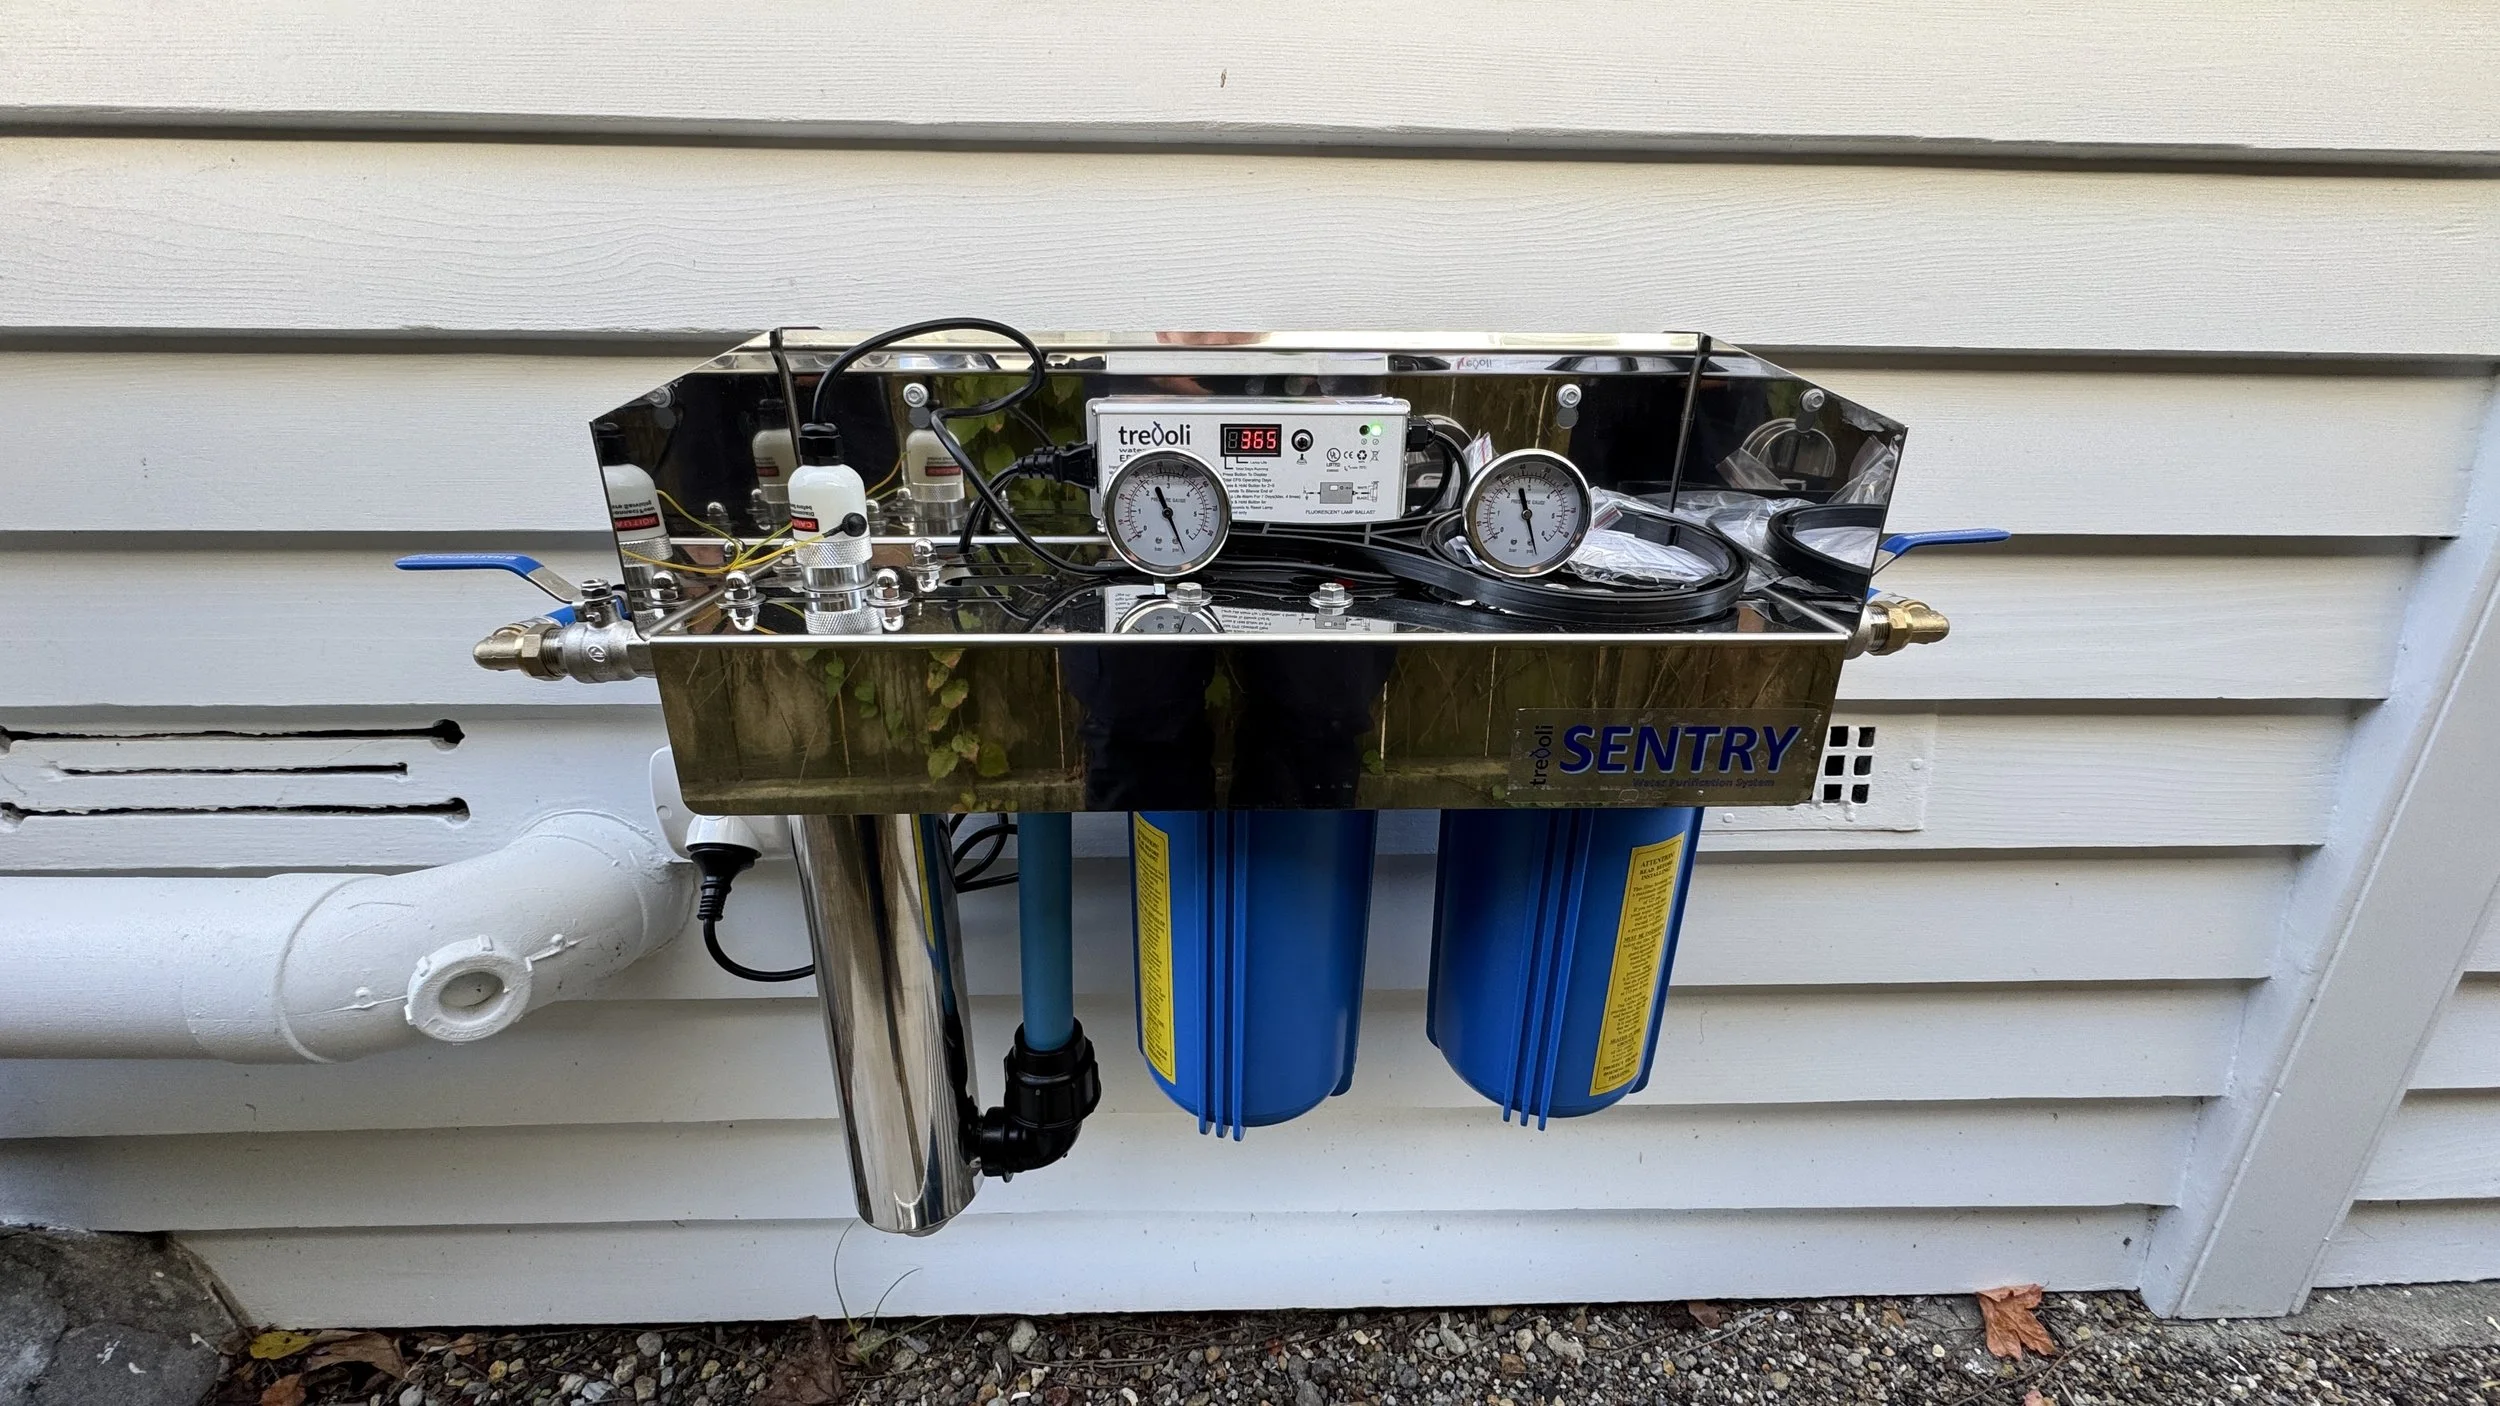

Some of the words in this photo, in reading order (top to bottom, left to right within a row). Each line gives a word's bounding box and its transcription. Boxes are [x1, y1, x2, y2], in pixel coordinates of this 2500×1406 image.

[1241, 430, 1276, 449] 365
[1559, 724, 1802, 774] SENTRY
[1633, 777, 1667, 787] Water
[1669, 777, 1733, 787] Purification
[1735, 777, 1775, 788] System
